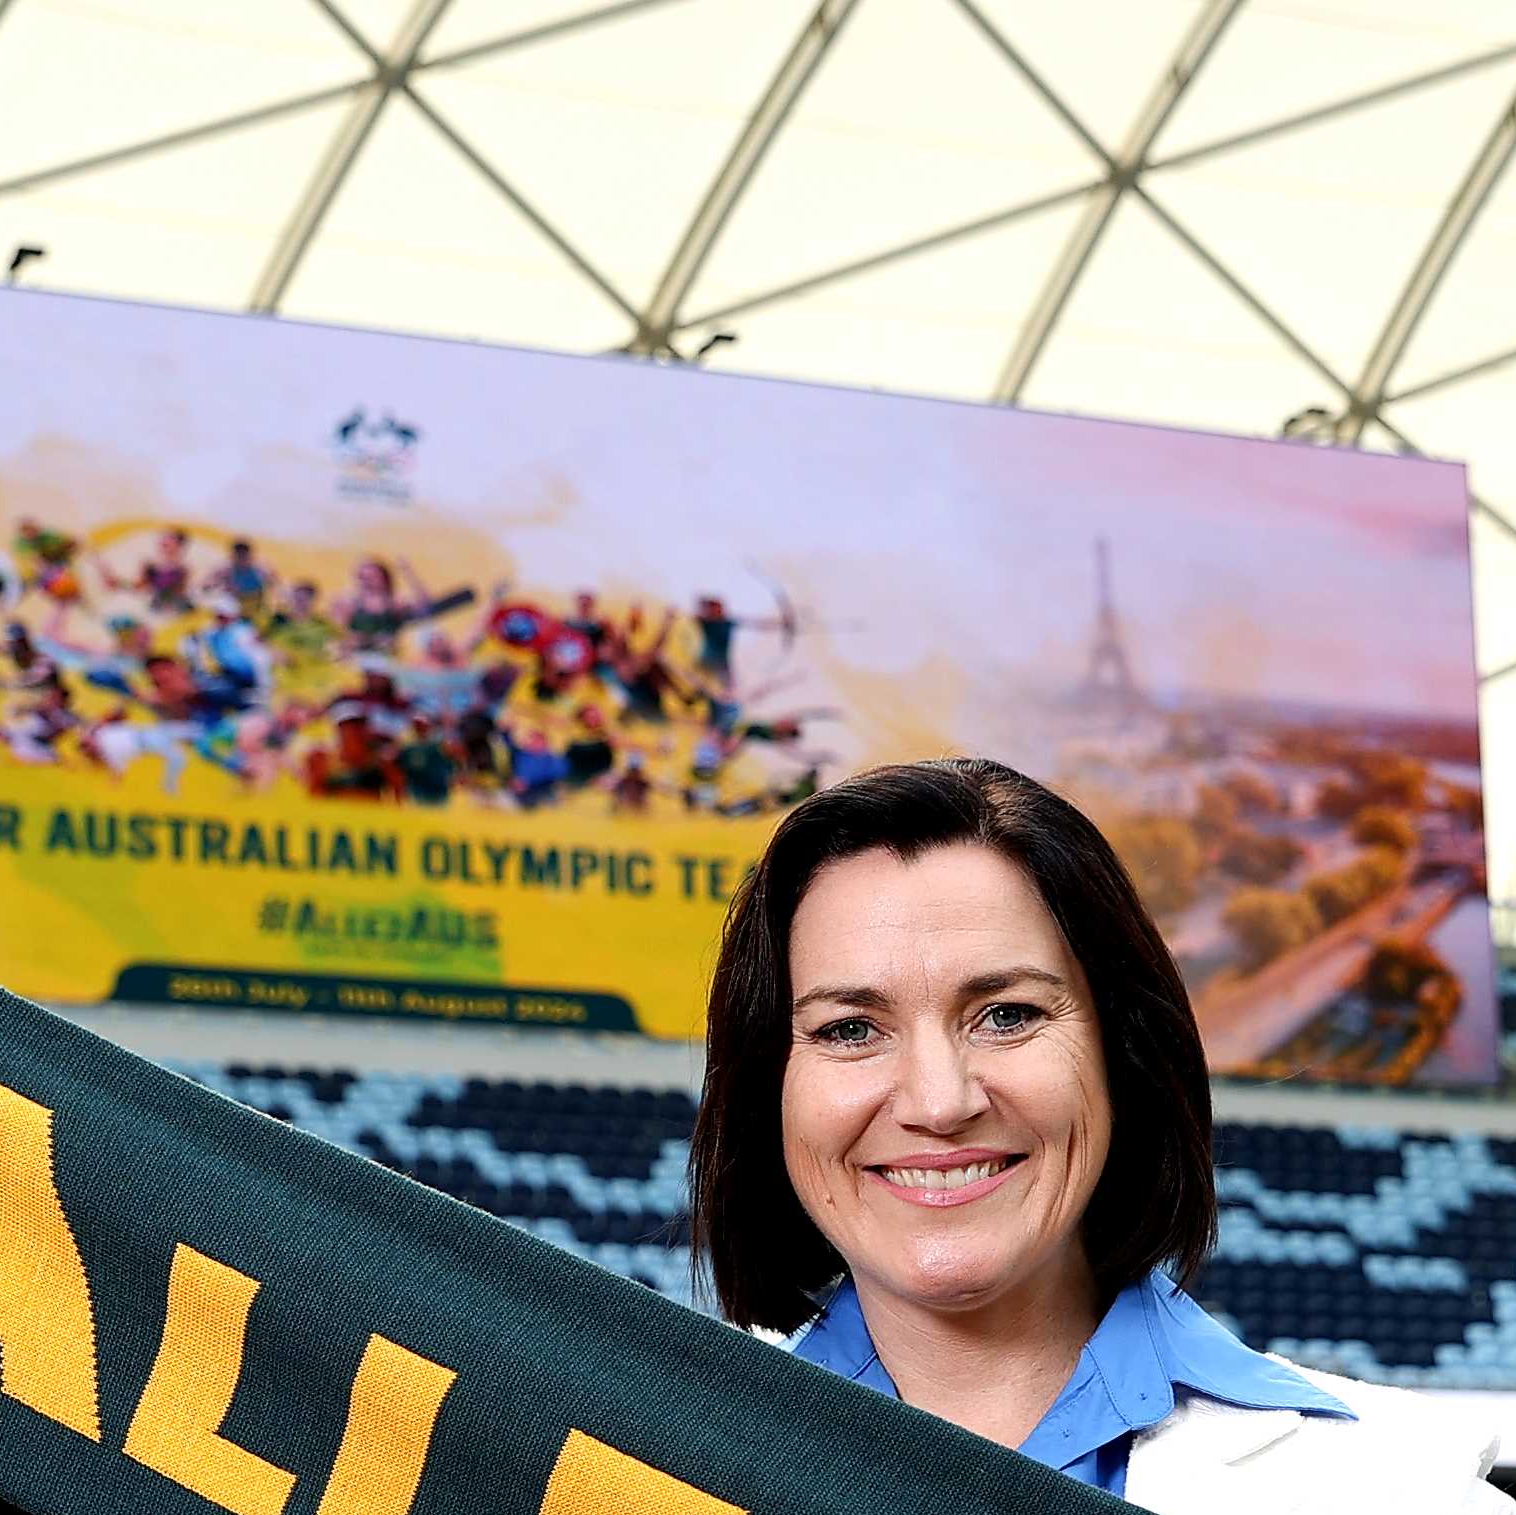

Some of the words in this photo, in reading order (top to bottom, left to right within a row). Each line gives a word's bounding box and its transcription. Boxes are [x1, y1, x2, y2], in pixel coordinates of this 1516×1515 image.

[47, 808, 398, 876] AUSTRALIAN
[421, 836, 654, 896] OLYMPIC
[676, 854, 761, 902] TE
